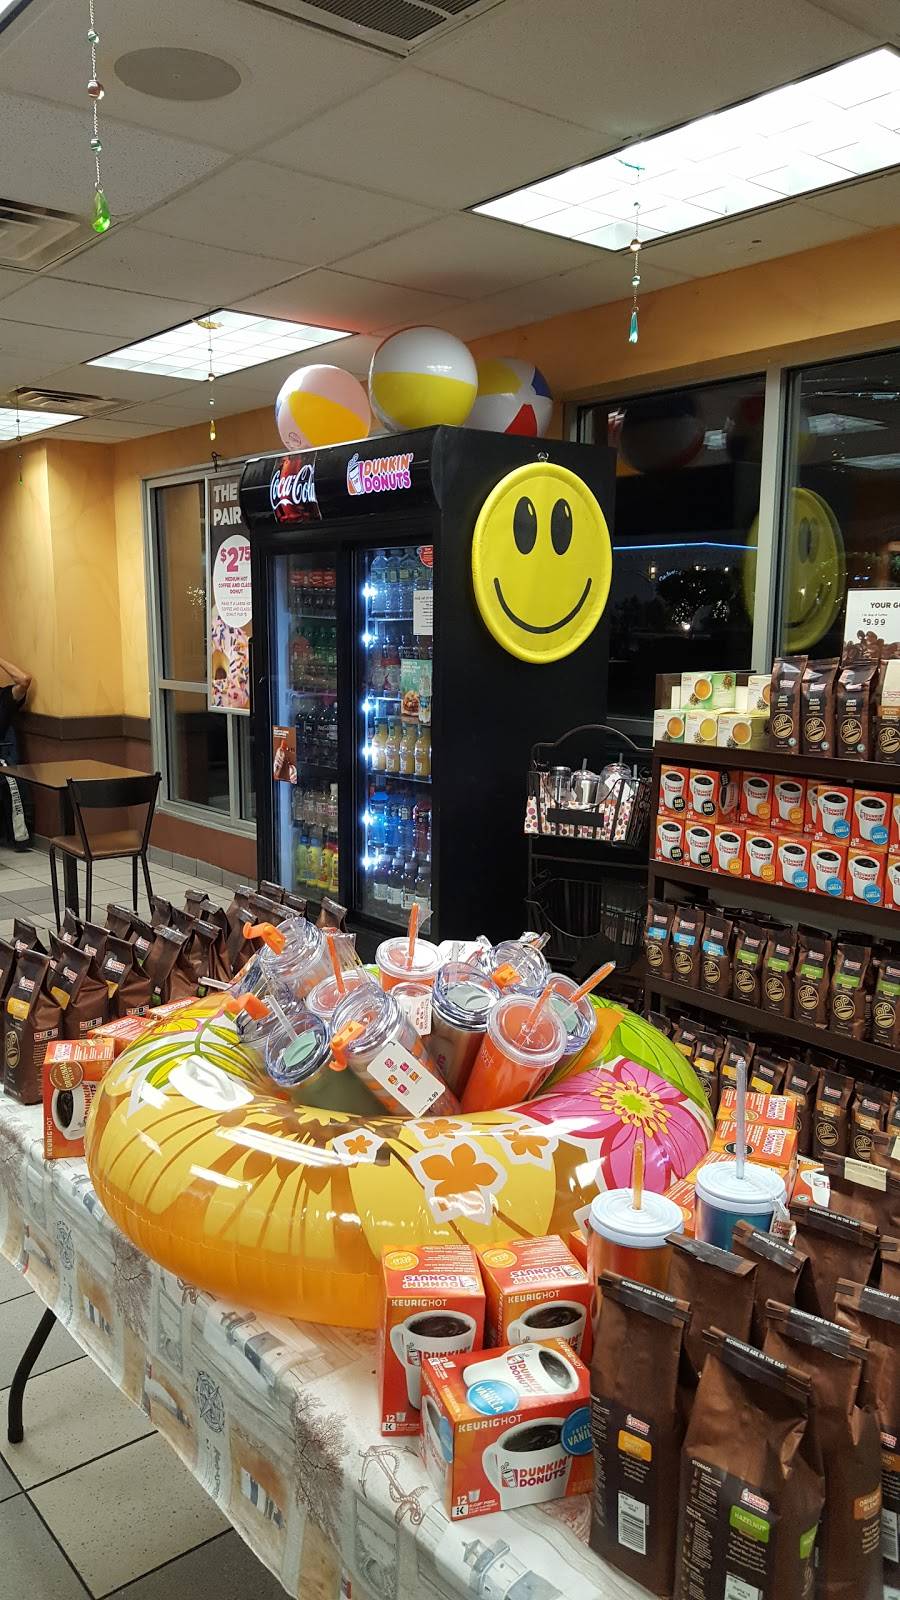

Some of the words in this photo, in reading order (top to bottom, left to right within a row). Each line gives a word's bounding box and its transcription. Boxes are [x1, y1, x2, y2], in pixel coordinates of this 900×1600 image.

[364, 453, 414, 476] DUNKIN'
[364, 471, 412, 493] DONUTS
[213, 483, 238, 503] THE
[213, 506, 242, 526] PAIR
[863, 618, 886, 626] $9.99
[404, 1274, 458, 1282] DONUTS
[510, 1266, 561, 1279] DONUTS
[475, 1386, 504, 1413] VANILLA
[519, 1454, 571, 1478] DUNKIN'
[519, 1467, 567, 1488] DONUTS
[456, 1495, 468, 1506] 12
[734, 1511, 767, 1532] HAZELNUT
